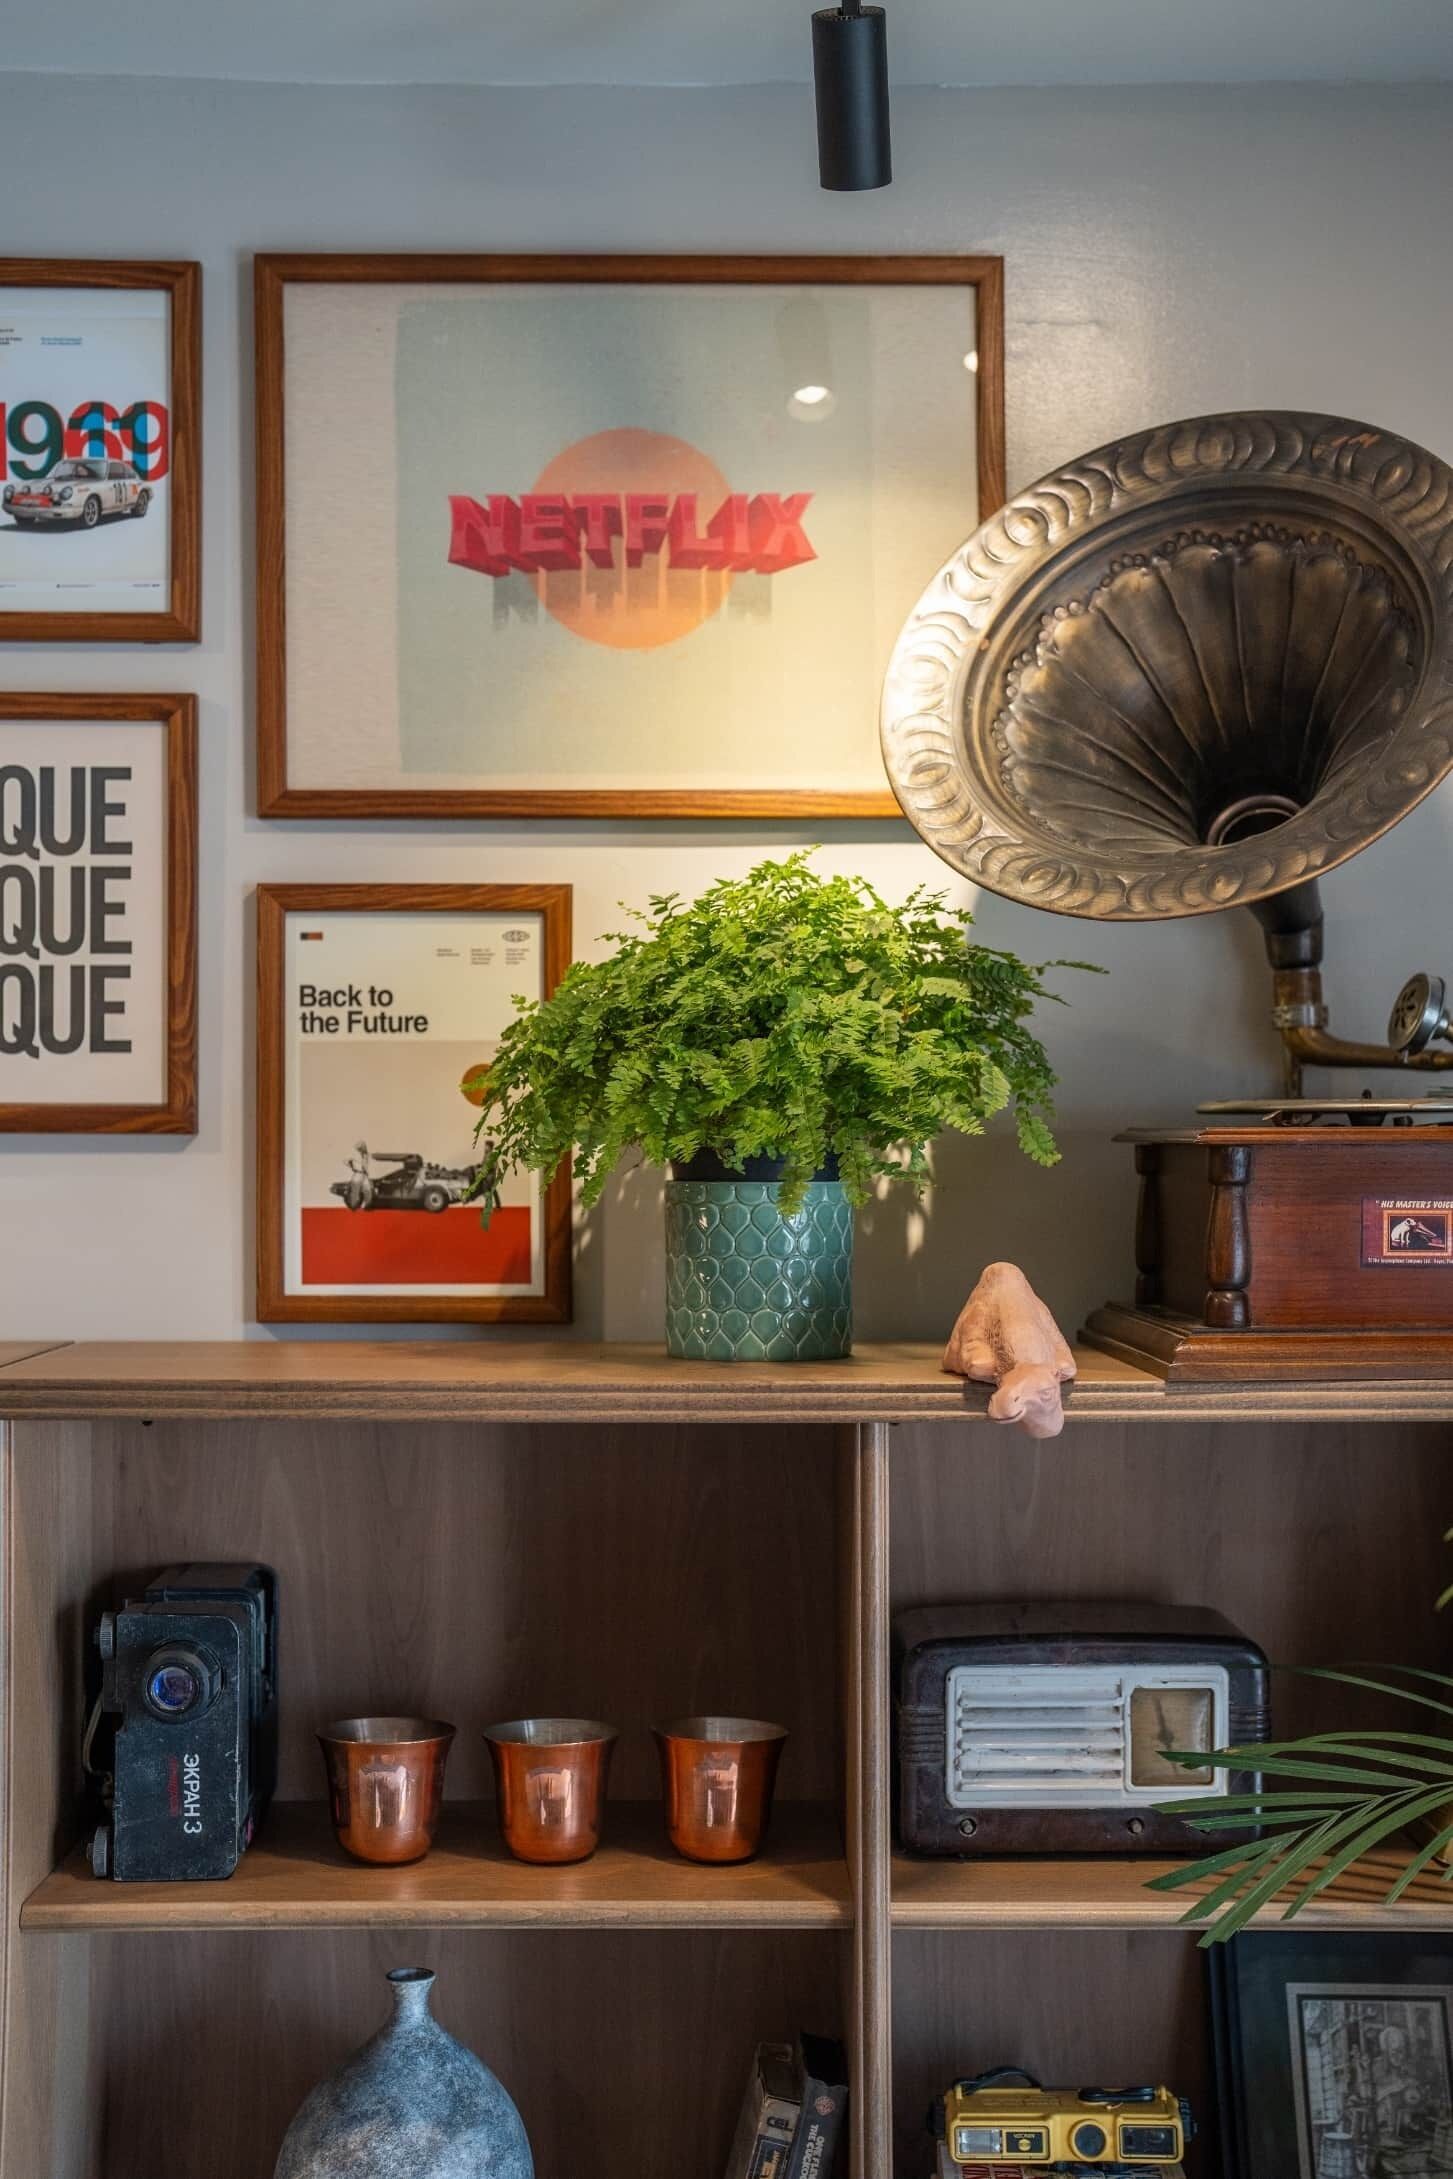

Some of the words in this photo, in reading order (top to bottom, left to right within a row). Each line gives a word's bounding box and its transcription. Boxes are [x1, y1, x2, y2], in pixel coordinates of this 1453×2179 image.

[448, 492, 817, 575] NETFLIX
[0, 765, 133, 860] QUE
[0, 864, 133, 960] QUE
[0, 963, 132, 1059] QUE
[299, 984, 361, 1008] Back
[368, 986, 393, 1008] to
[300, 1010, 340, 1033] the
[347, 1010, 429, 1033] Future
[184, 1754, 200, 1816] ЭКРАН
[184, 1821, 202, 1833] 3
